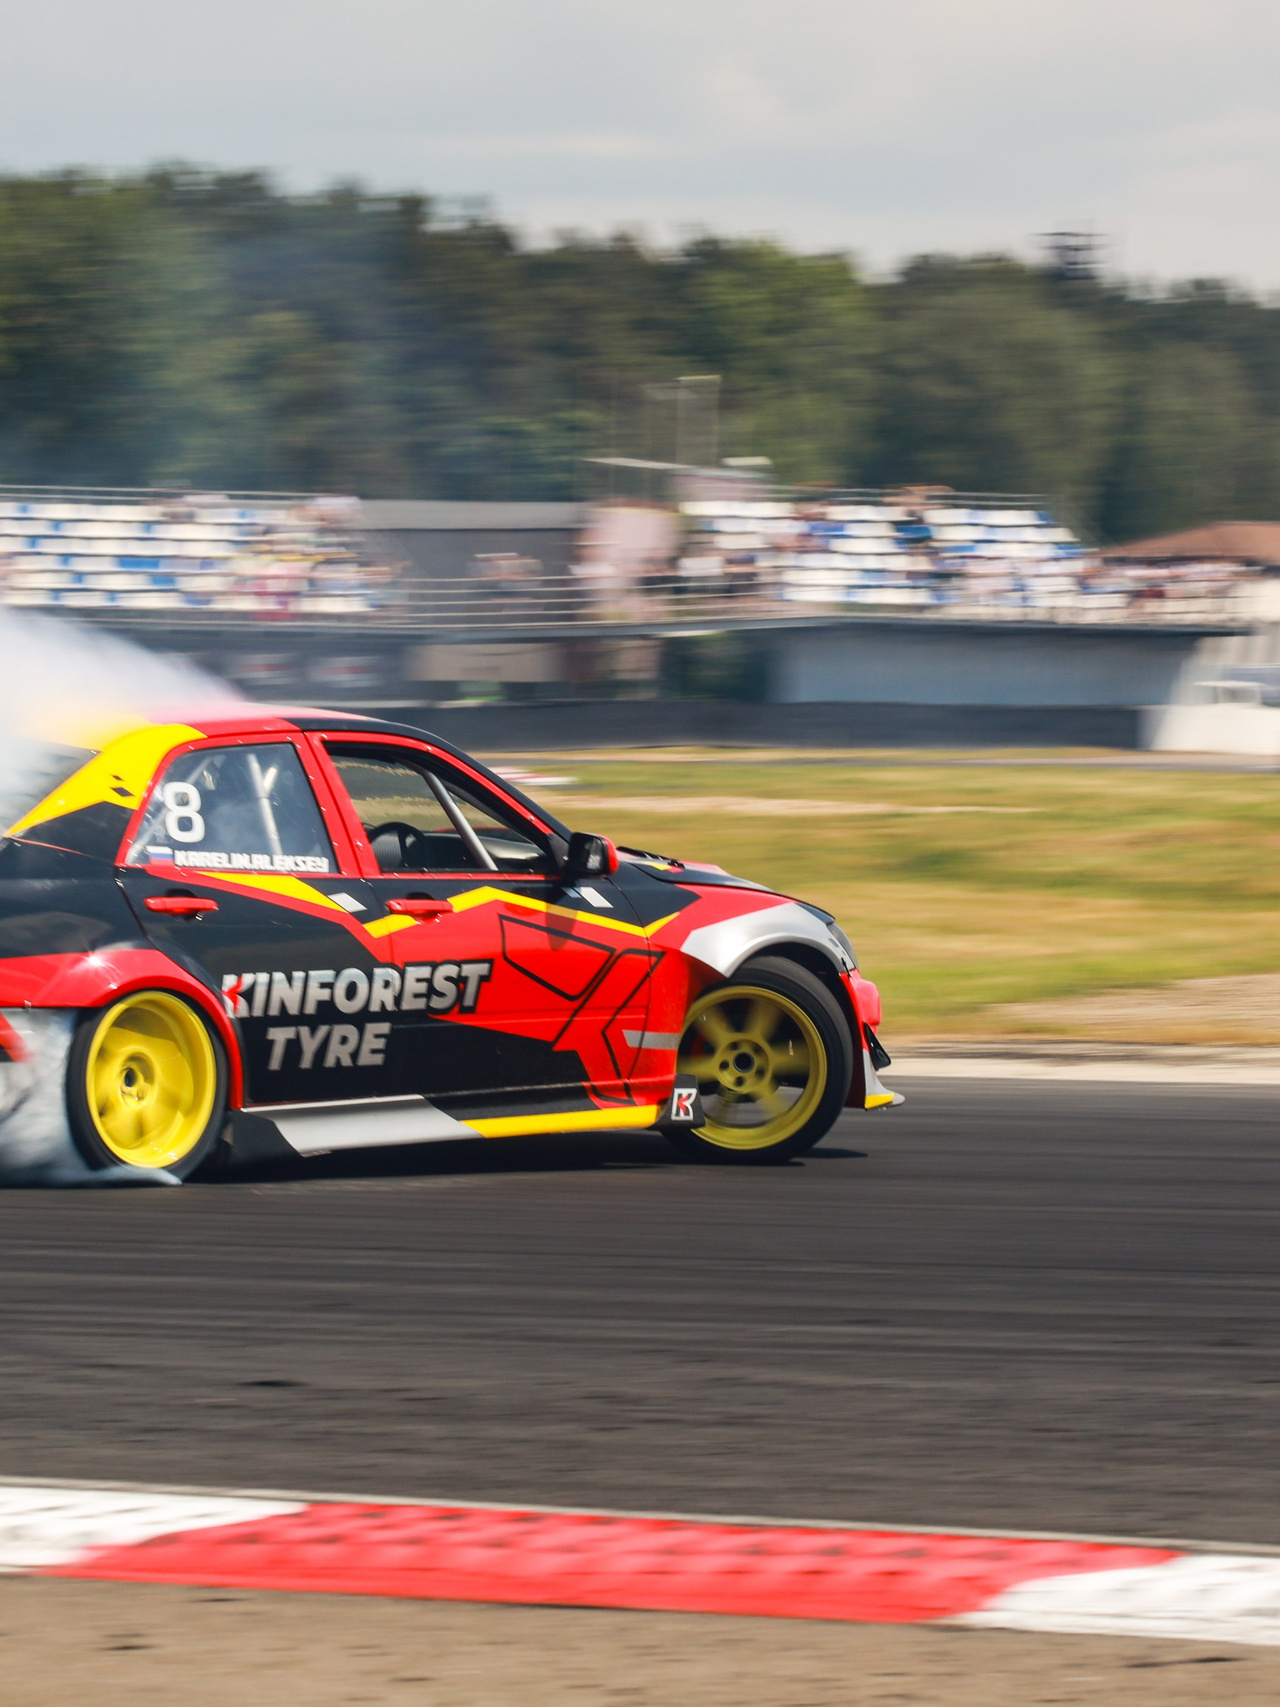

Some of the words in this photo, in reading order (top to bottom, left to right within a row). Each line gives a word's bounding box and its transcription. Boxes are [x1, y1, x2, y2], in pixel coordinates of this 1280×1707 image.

[163, 781, 205, 843] 8
[221, 962, 491, 1019] KINFOREST
[266, 1022, 392, 1071] TYRE
